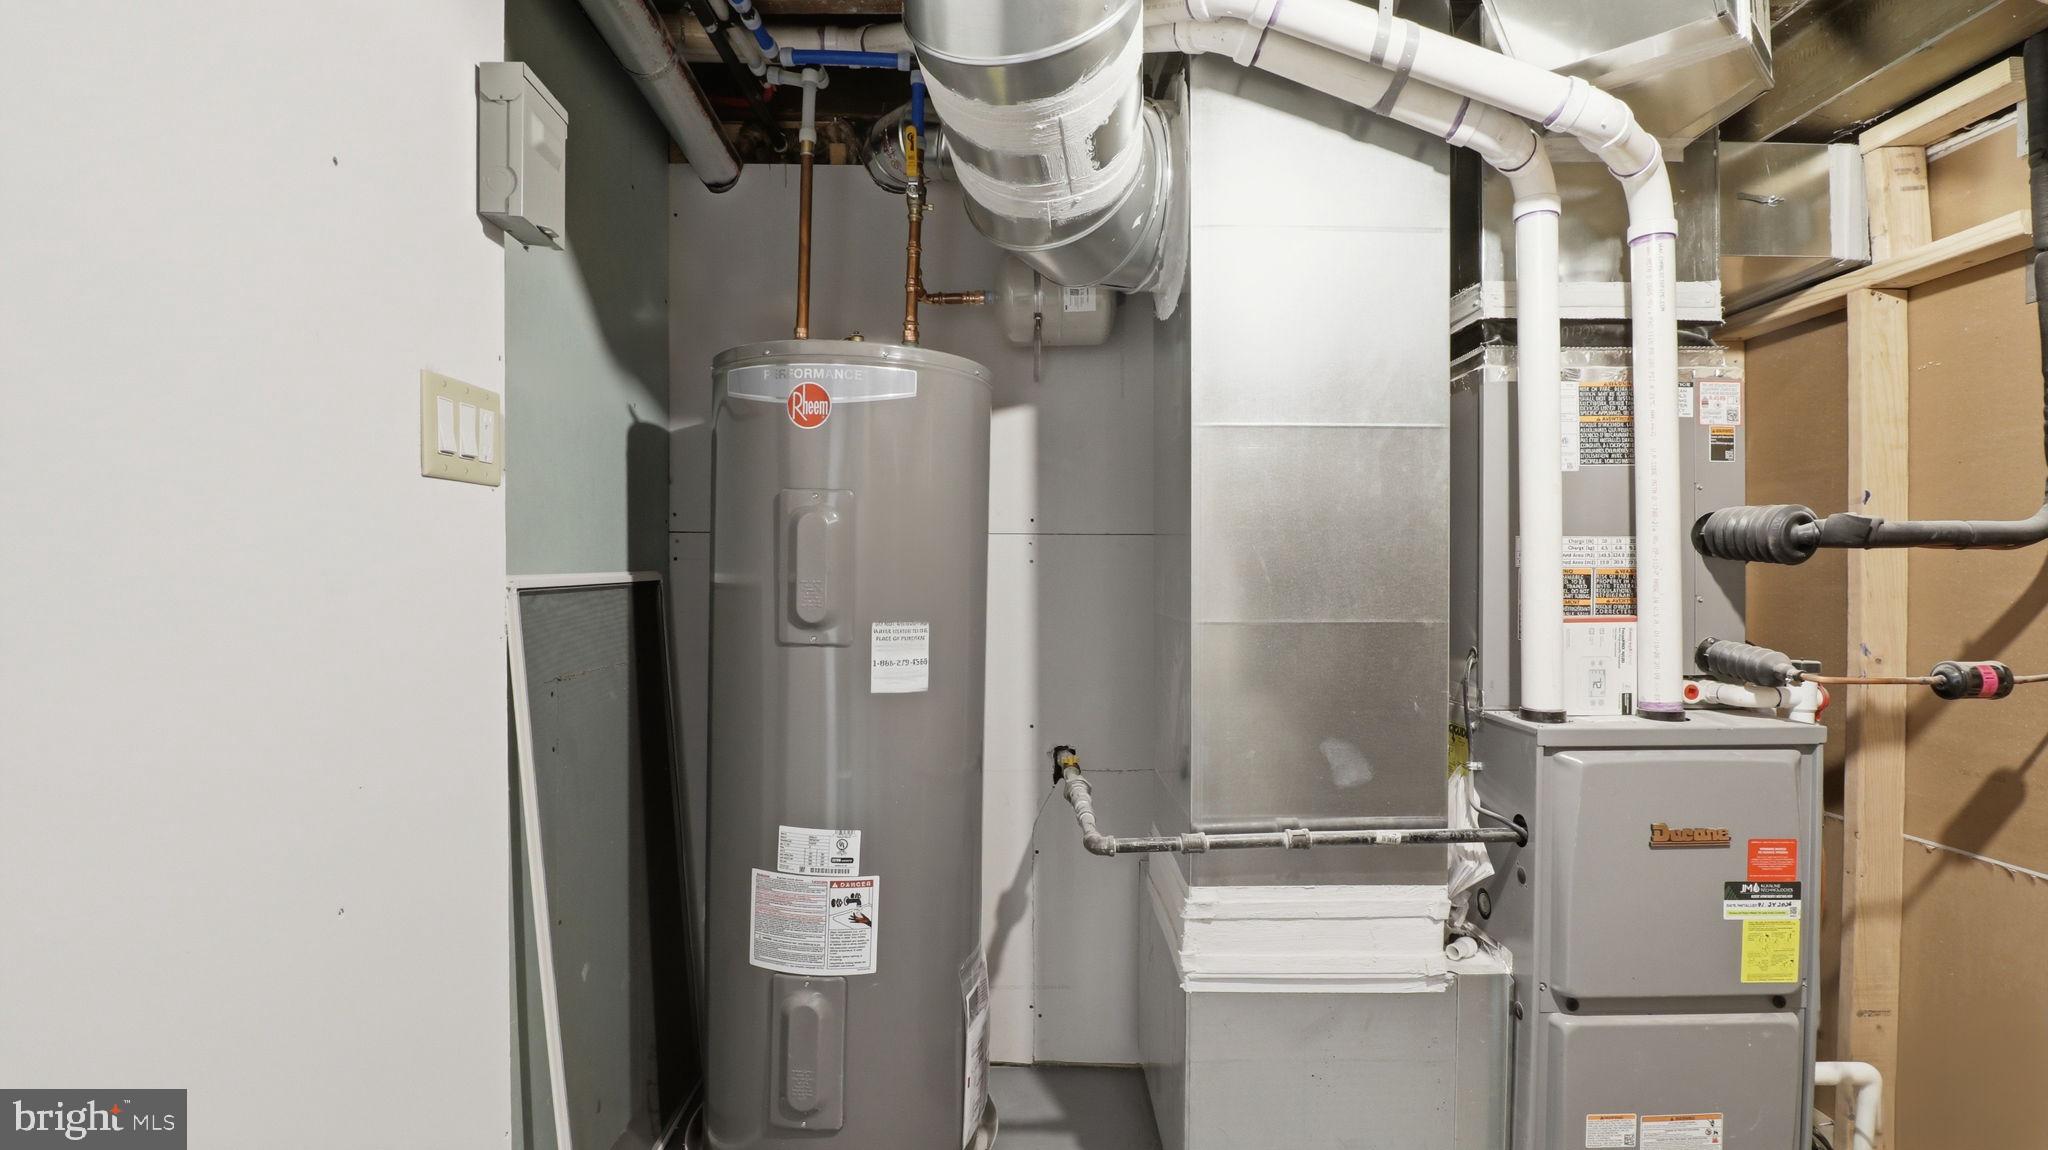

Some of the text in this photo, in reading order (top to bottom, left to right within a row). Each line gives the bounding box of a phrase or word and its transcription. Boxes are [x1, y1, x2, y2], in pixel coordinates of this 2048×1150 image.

[763, 367, 863, 380] PERFORMANCE
[792, 384, 829, 422] Rheem
[1651, 823, 1731, 842] Ducane
